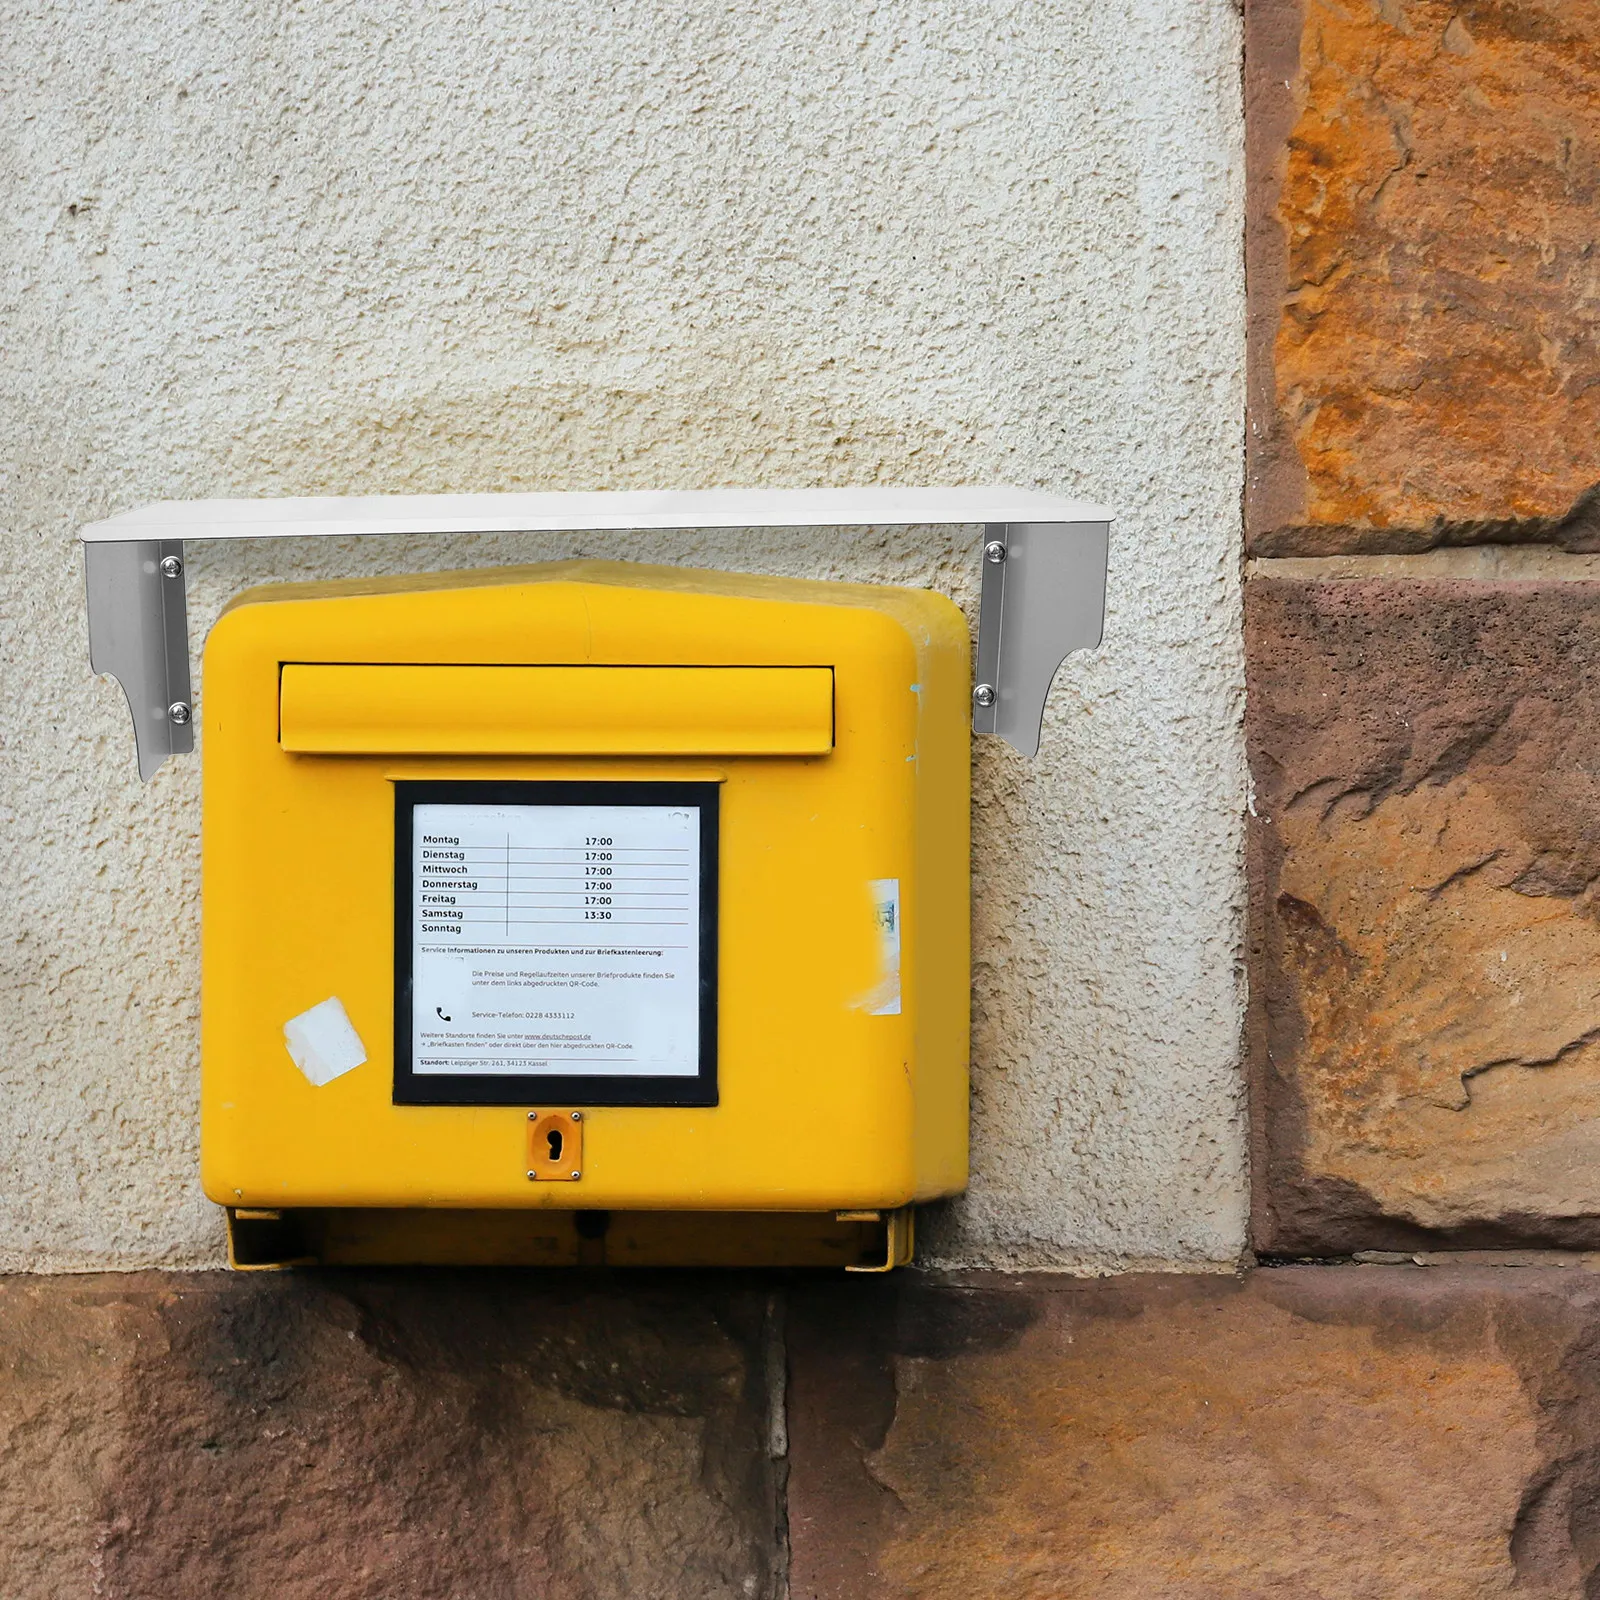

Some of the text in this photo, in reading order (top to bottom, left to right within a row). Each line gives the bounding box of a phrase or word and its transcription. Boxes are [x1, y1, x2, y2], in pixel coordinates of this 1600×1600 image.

[423, 836, 613, 846] Montag 17:00
[423, 851, 613, 861] Dienstag 17:00
[423, 865, 612, 875] Mittwoch 17:00
[422, 880, 612, 890] Donnerstag 17:00
[422, 895, 612, 905] Freitag 17:00
[422, 910, 612, 920] Samstag 13:30
[422, 924, 461, 934] Sonntag
[523, 980, 568, 988] abgedruckten
